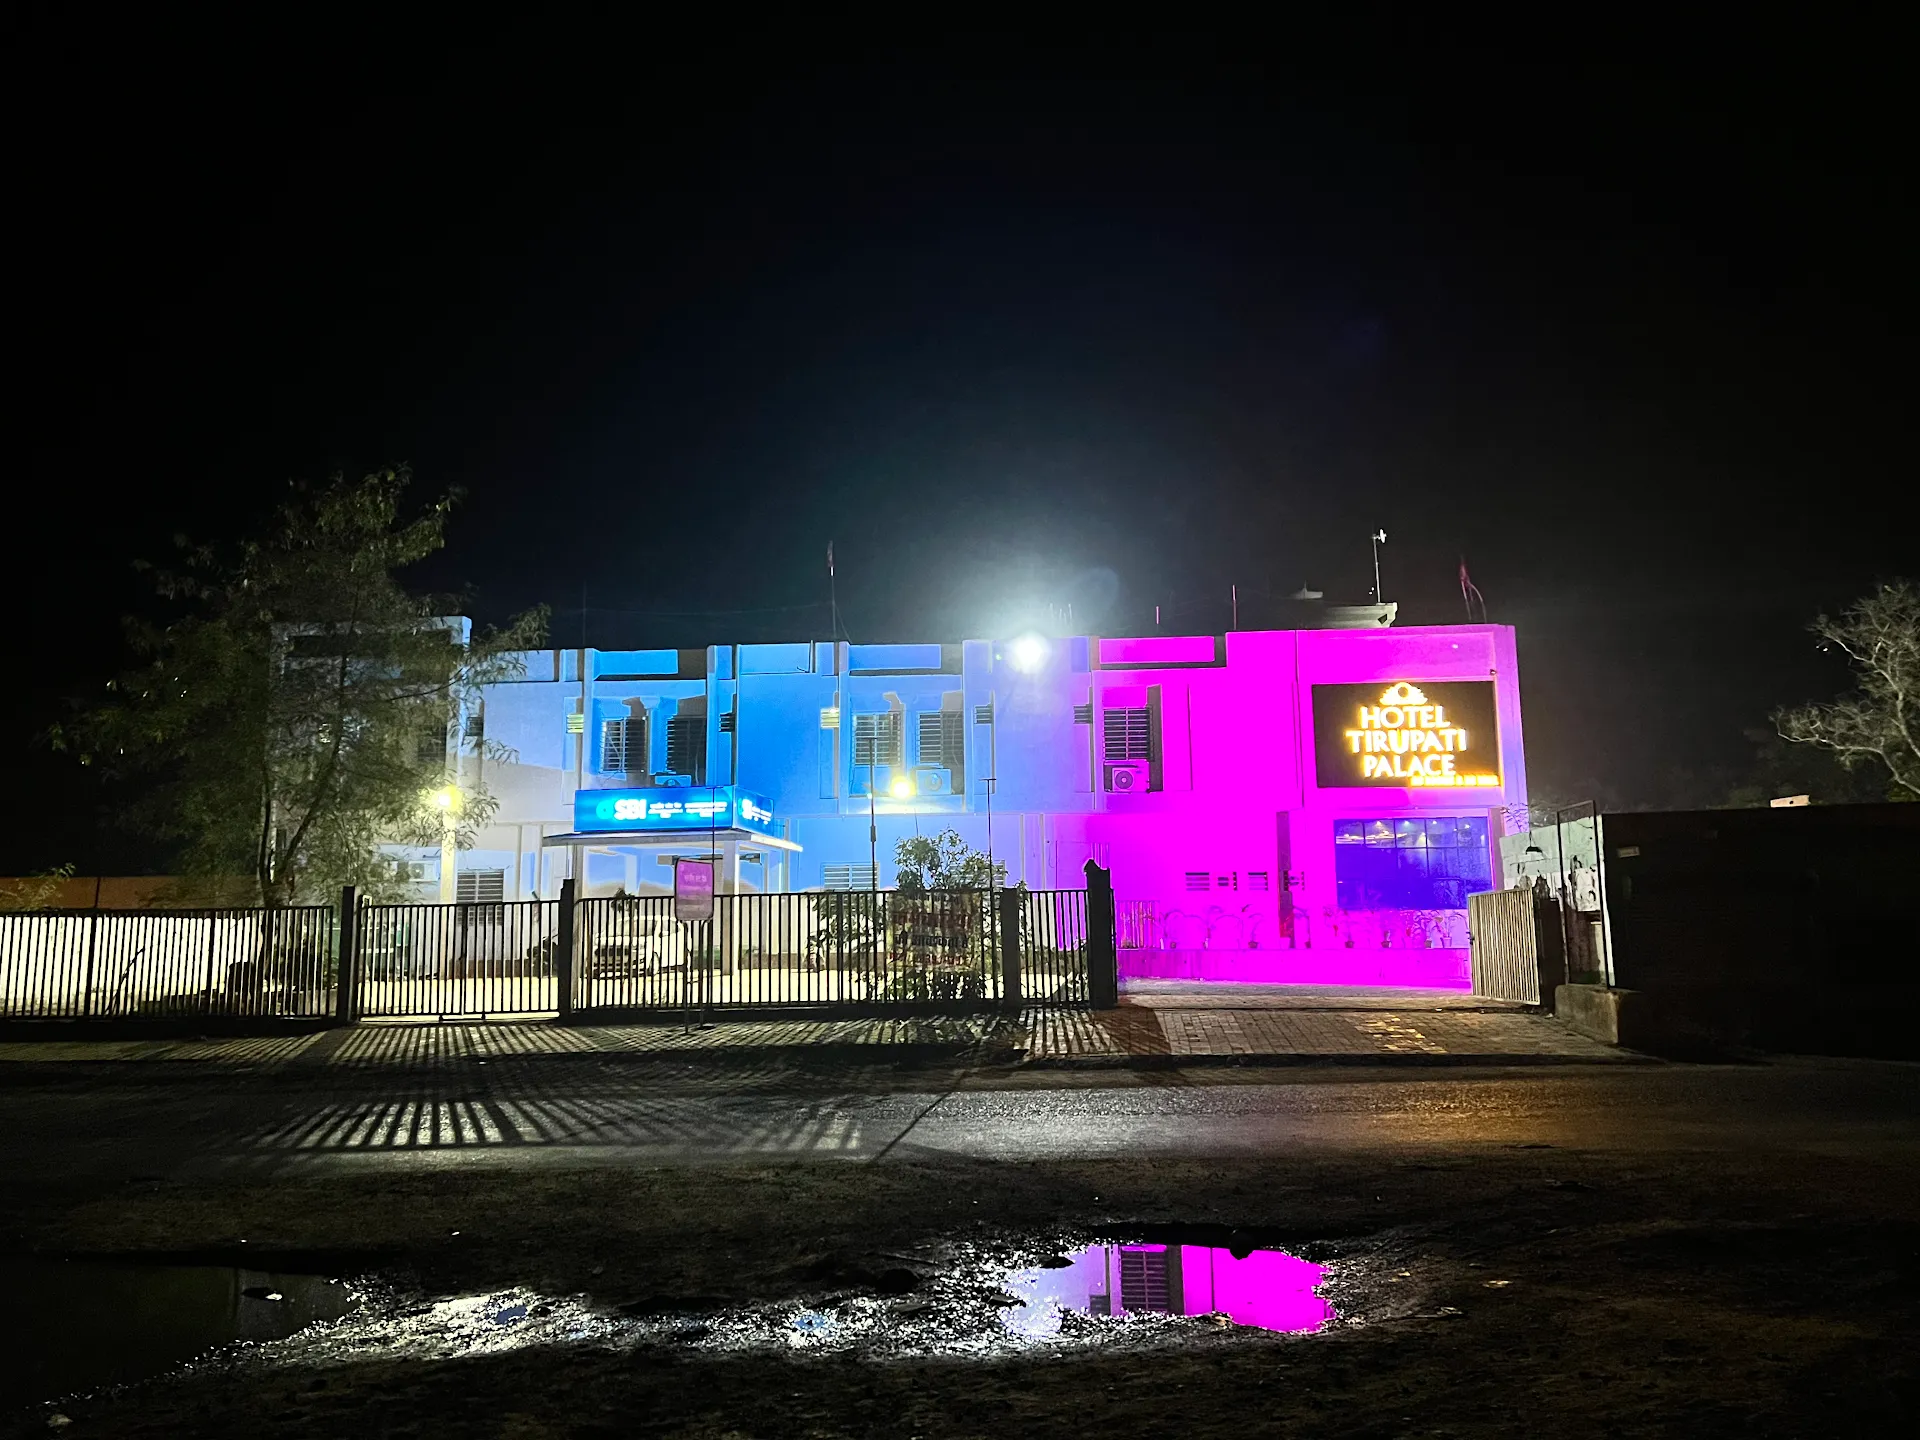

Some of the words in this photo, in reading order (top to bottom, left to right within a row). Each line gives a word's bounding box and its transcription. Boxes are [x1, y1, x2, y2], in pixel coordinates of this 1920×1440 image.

[1360, 705, 1451, 729] HOTEL
[1345, 728, 1468, 754] TIRUPATI
[1363, 754, 1457, 778] PALACE
[613, 799, 647, 820] SBI
